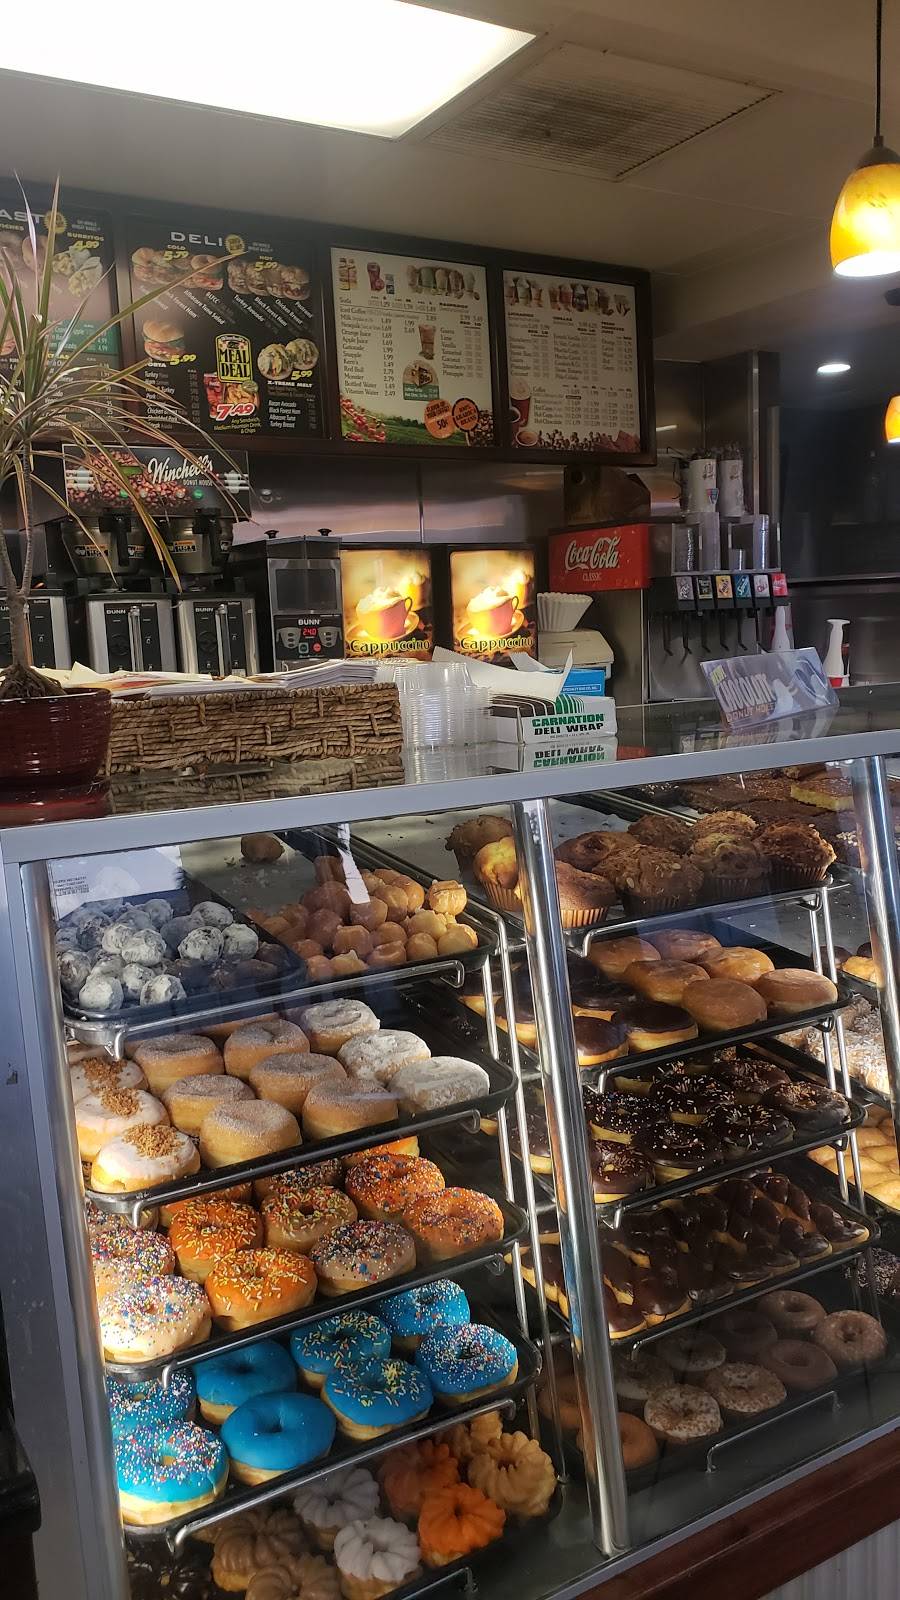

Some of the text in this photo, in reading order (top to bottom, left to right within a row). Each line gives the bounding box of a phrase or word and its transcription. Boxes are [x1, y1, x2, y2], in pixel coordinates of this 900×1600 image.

[170, 231, 223, 247] DELI
[219, 350, 250, 363] MEAL
[220, 363, 250, 378] DEAL
[216, 403, 256, 421] 7.49
[148, 454, 213, 484] Winchell's
[183, 479, 200, 487] DONUT
[565, 535, 622, 573] Coca-Cola
[298, 618, 320, 626] BUNN
[350, 637, 431, 655] Cappuccino
[460, 635, 534, 653] Cappuccino
[532, 713, 605, 728] CARNATION
[726, 706, 753, 721] DONUT
[534, 726, 562, 737] DELI
[565, 722, 605, 734] WRAP
